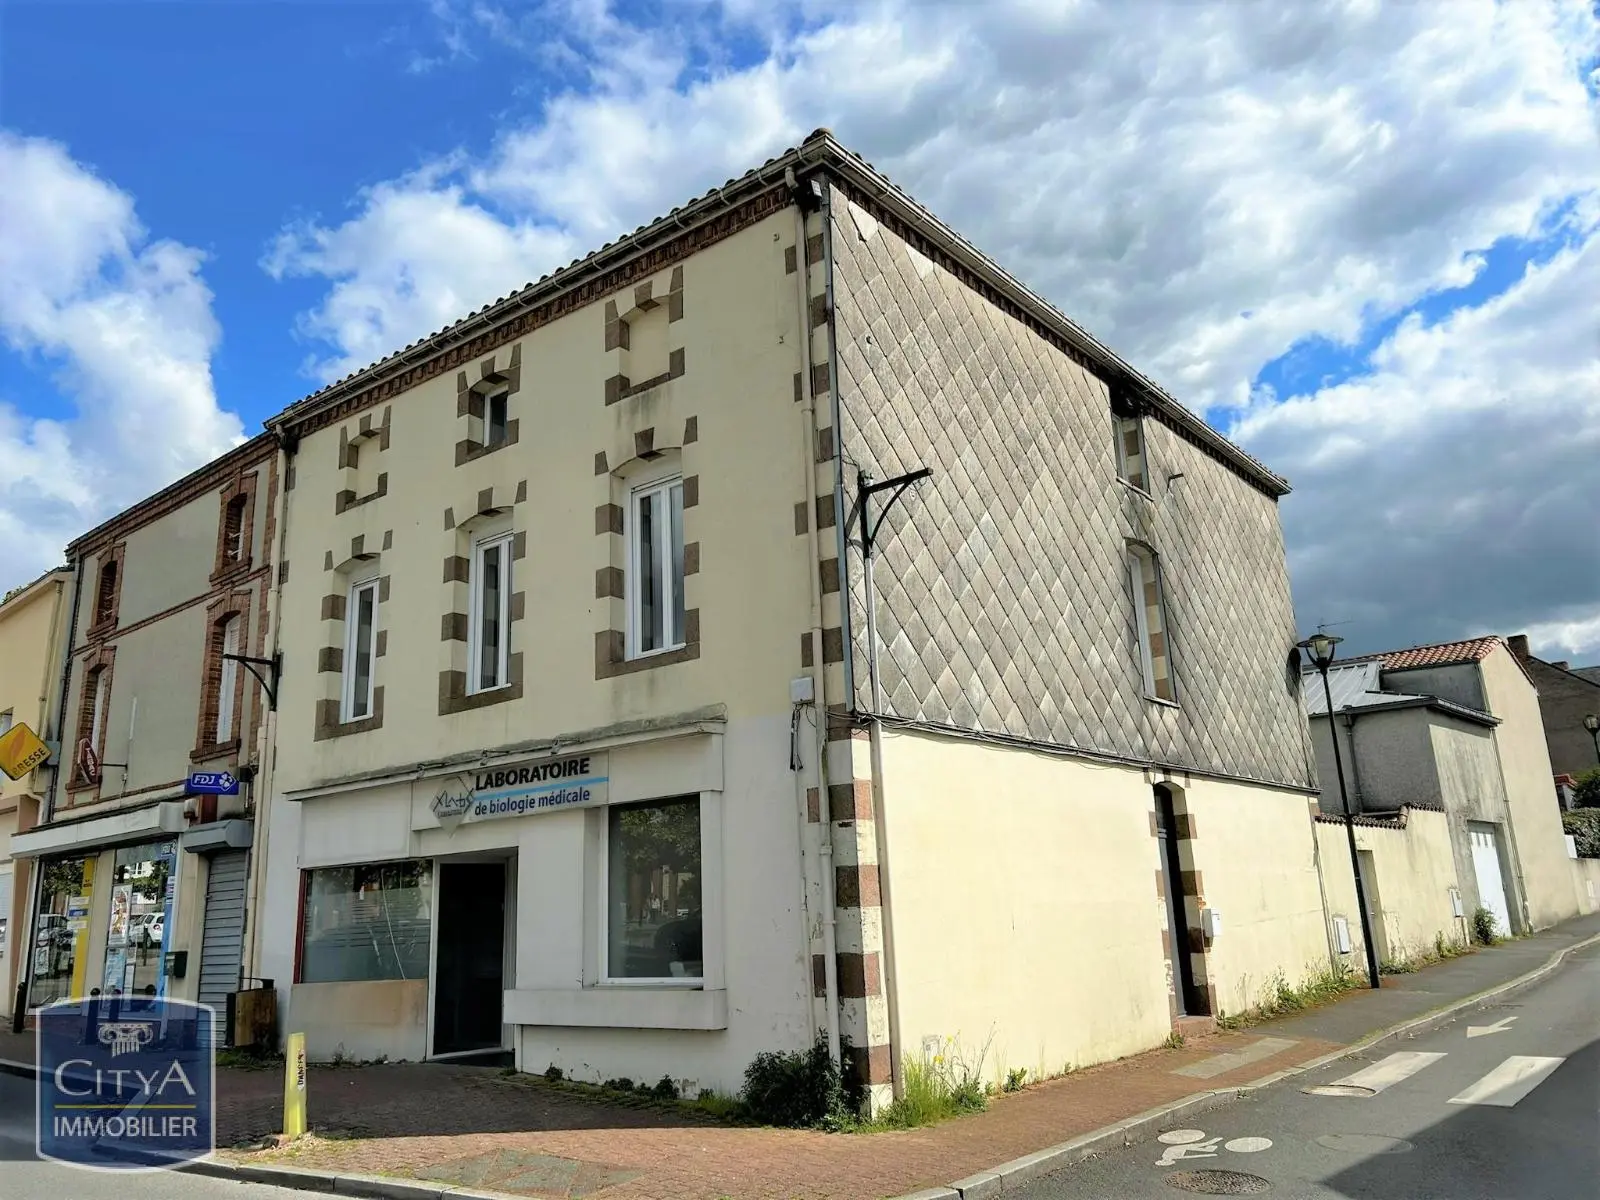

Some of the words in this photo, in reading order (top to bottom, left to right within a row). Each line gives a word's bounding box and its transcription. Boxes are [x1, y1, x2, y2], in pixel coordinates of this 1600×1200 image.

[12, 747, 46, 776] PRESSE
[85, 747, 96, 776] TABAC
[475, 757, 590, 791] LABORATOIRE
[193, 774, 216, 785] FDJ
[474, 801, 488, 816] de
[489, 794, 535, 815] biologie
[538, 786, 590, 807] médicale
